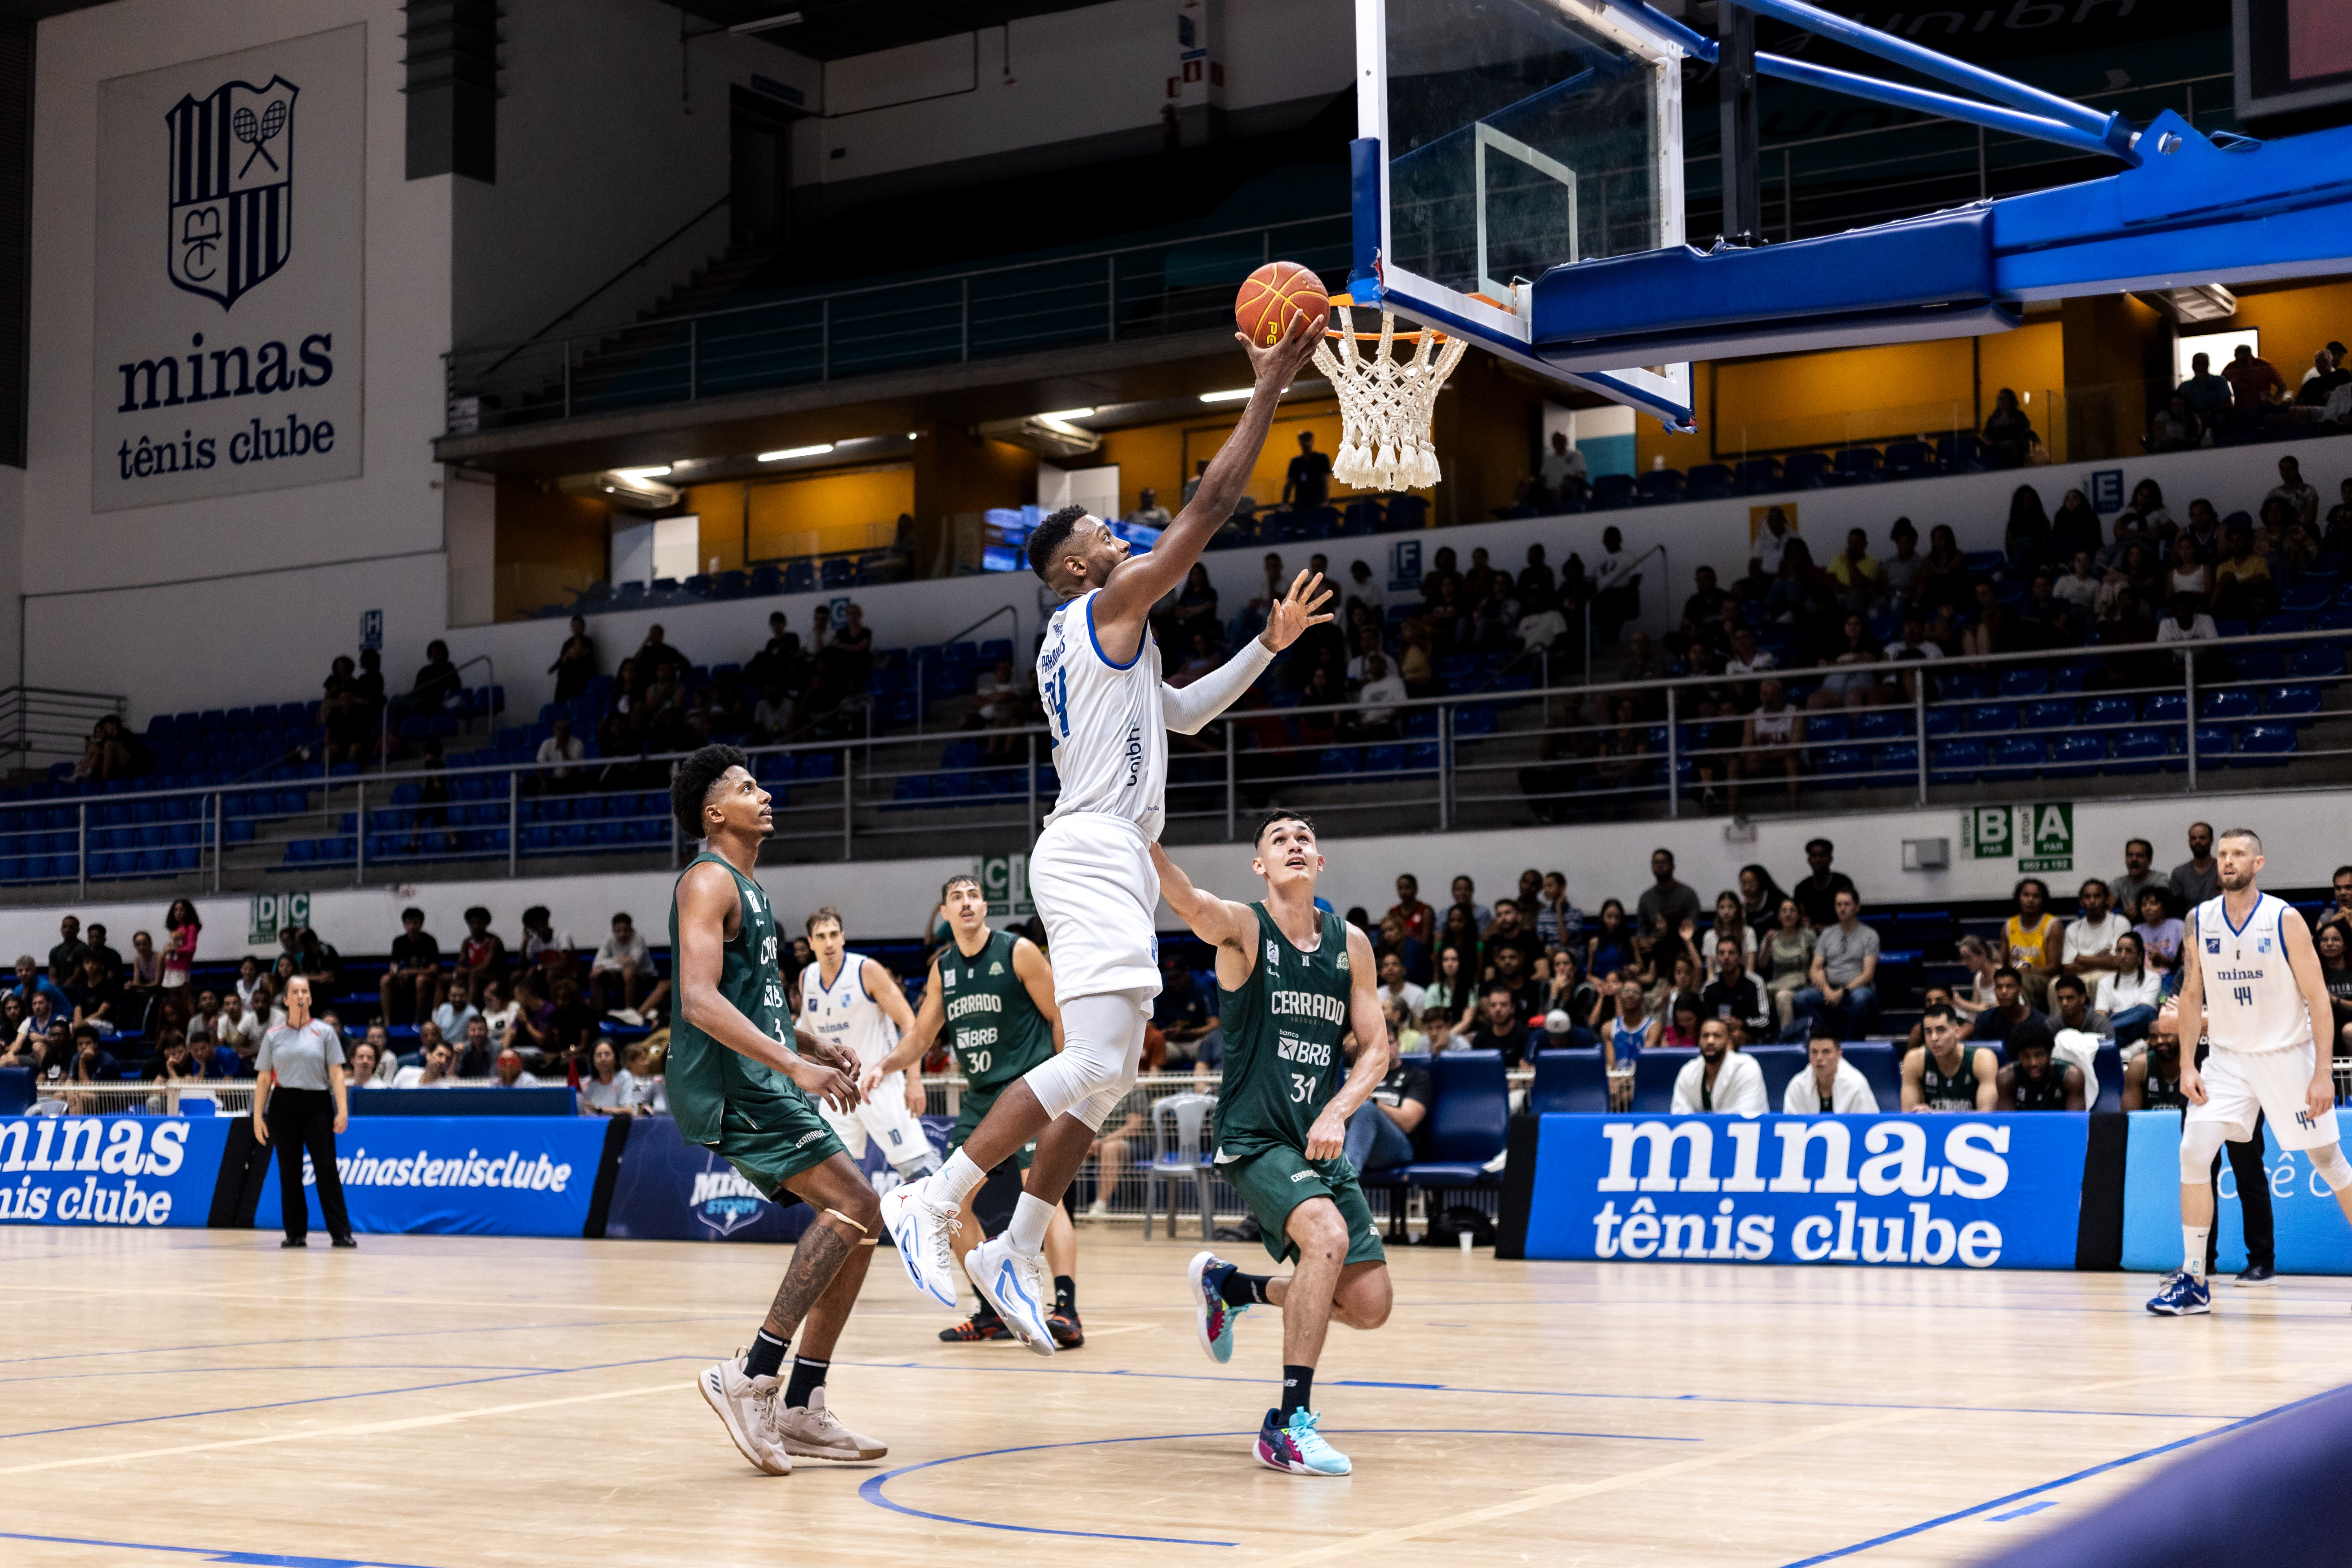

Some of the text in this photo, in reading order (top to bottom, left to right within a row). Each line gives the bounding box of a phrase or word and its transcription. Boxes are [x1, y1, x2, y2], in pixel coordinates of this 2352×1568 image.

[117, 333, 333, 413] minas
[118, 413, 334, 480] tênis clube
[2097, 474, 2118, 501] E
[1401, 544, 1416, 568] F
[367, 613, 380, 634] H
[1126, 728, 1141, 786] unibh
[1979, 808, 2008, 844] B
[2037, 804, 2069, 840] A
[2043, 841, 2063, 852] PAR
[985, 858, 1007, 889] C
[259, 896, 275, 921] D
[291, 894, 307, 921] C
[2218, 968, 2263, 980] minas
[947, 993, 1002, 1022] CERRADO
[1271, 991, 1345, 1026] CERRADO
[2234, 986, 2253, 1006] 44
[818, 1022, 849, 1033] minas
[969, 1027, 998, 1047] BRB
[1279, 1029, 1299, 1039] banco
[967, 1050, 992, 1074] 30
[1296, 1041, 1331, 1066] BRB
[1290, 1072, 1316, 1105] 31
[795, 1129, 826, 1149] CERRADO
[888, 1128, 902, 1147] 10
[1598, 1119, 2010, 1199] minas
[689, 1172, 773, 1207] MINA
[1291, 1170, 1320, 1183] CERRA
[57, 1175, 172, 1225] clube
[706, 1198, 758, 1214] STORM
[1593, 1196, 2002, 1268] tênis clube
